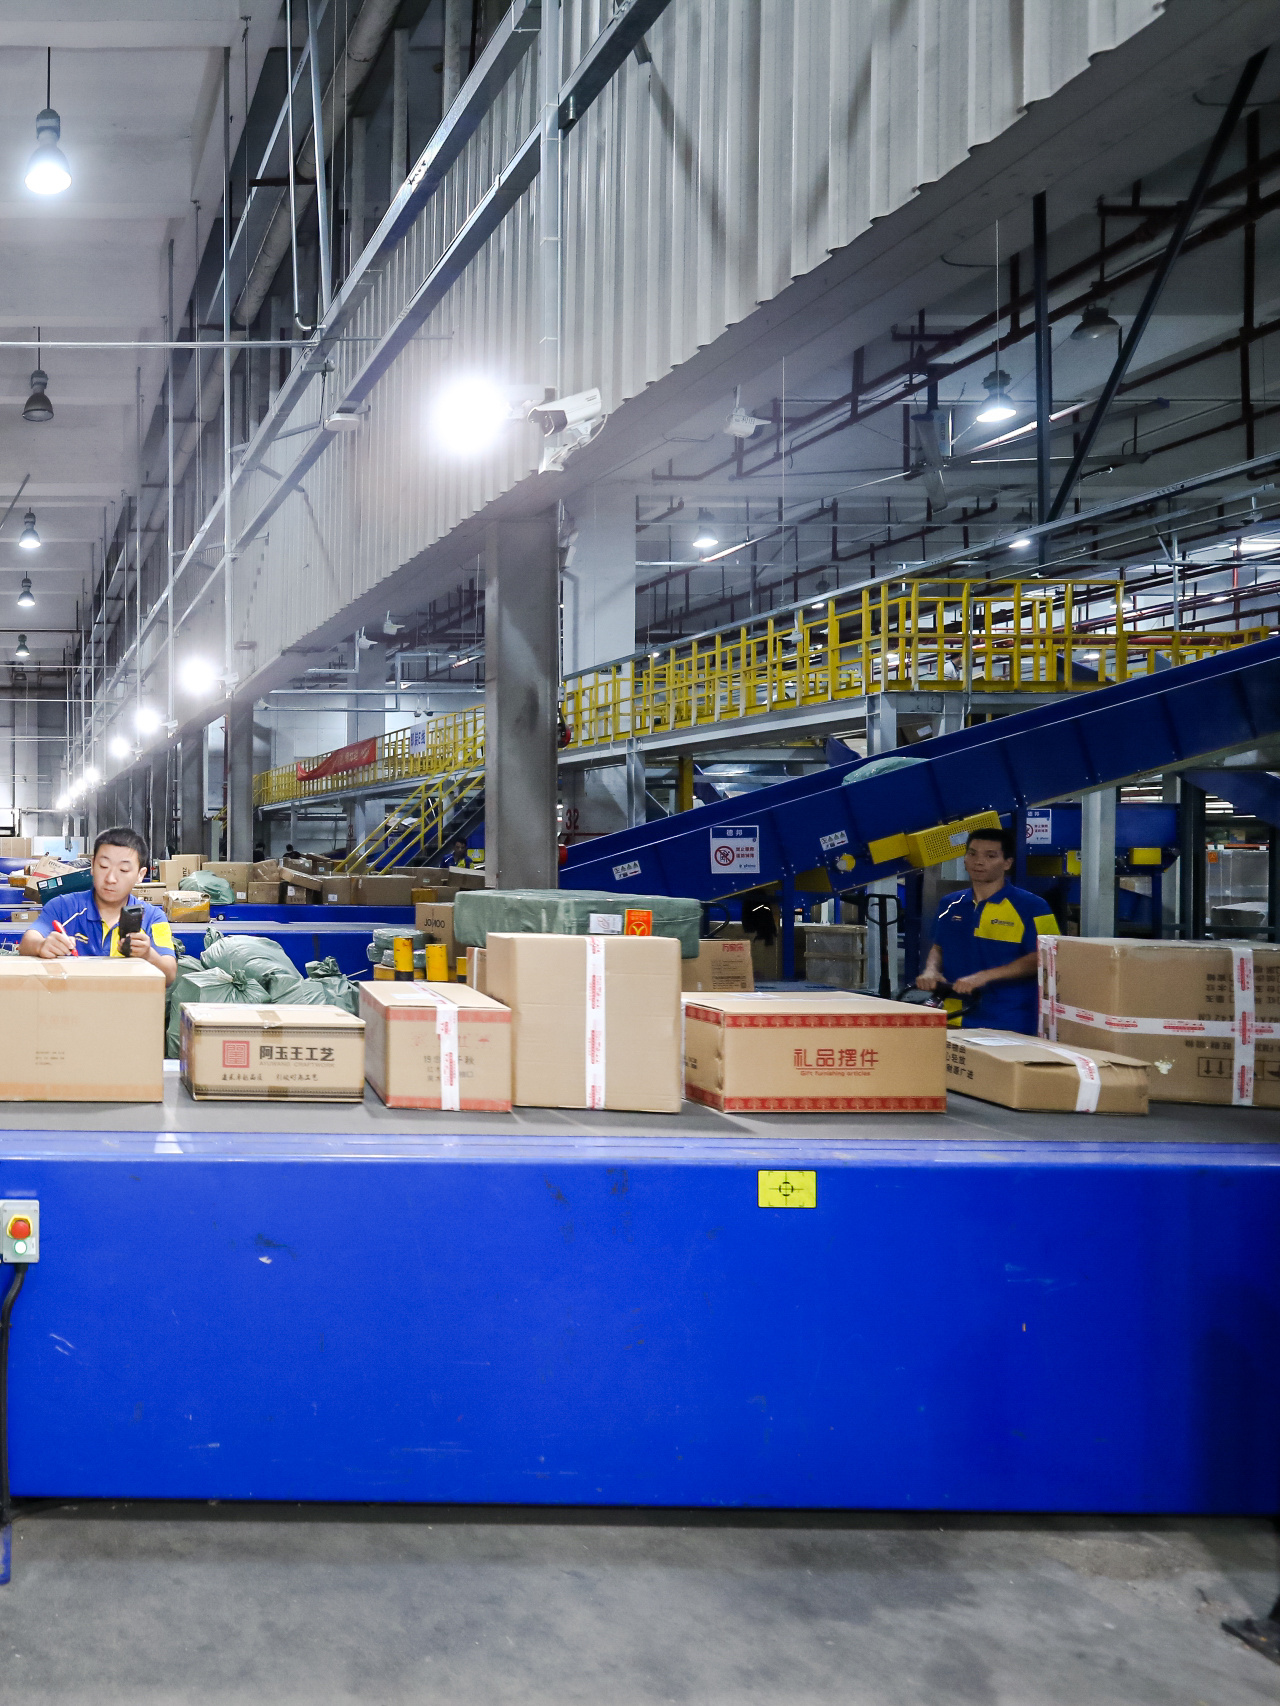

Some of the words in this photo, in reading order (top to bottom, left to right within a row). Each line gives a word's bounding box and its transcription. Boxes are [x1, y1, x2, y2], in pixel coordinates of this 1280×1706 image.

[565, 808, 580, 830] 32
[259, 1045, 335, 1062] 阿玉王工艺
[793, 1048, 879, 1067] 礼品摆件
